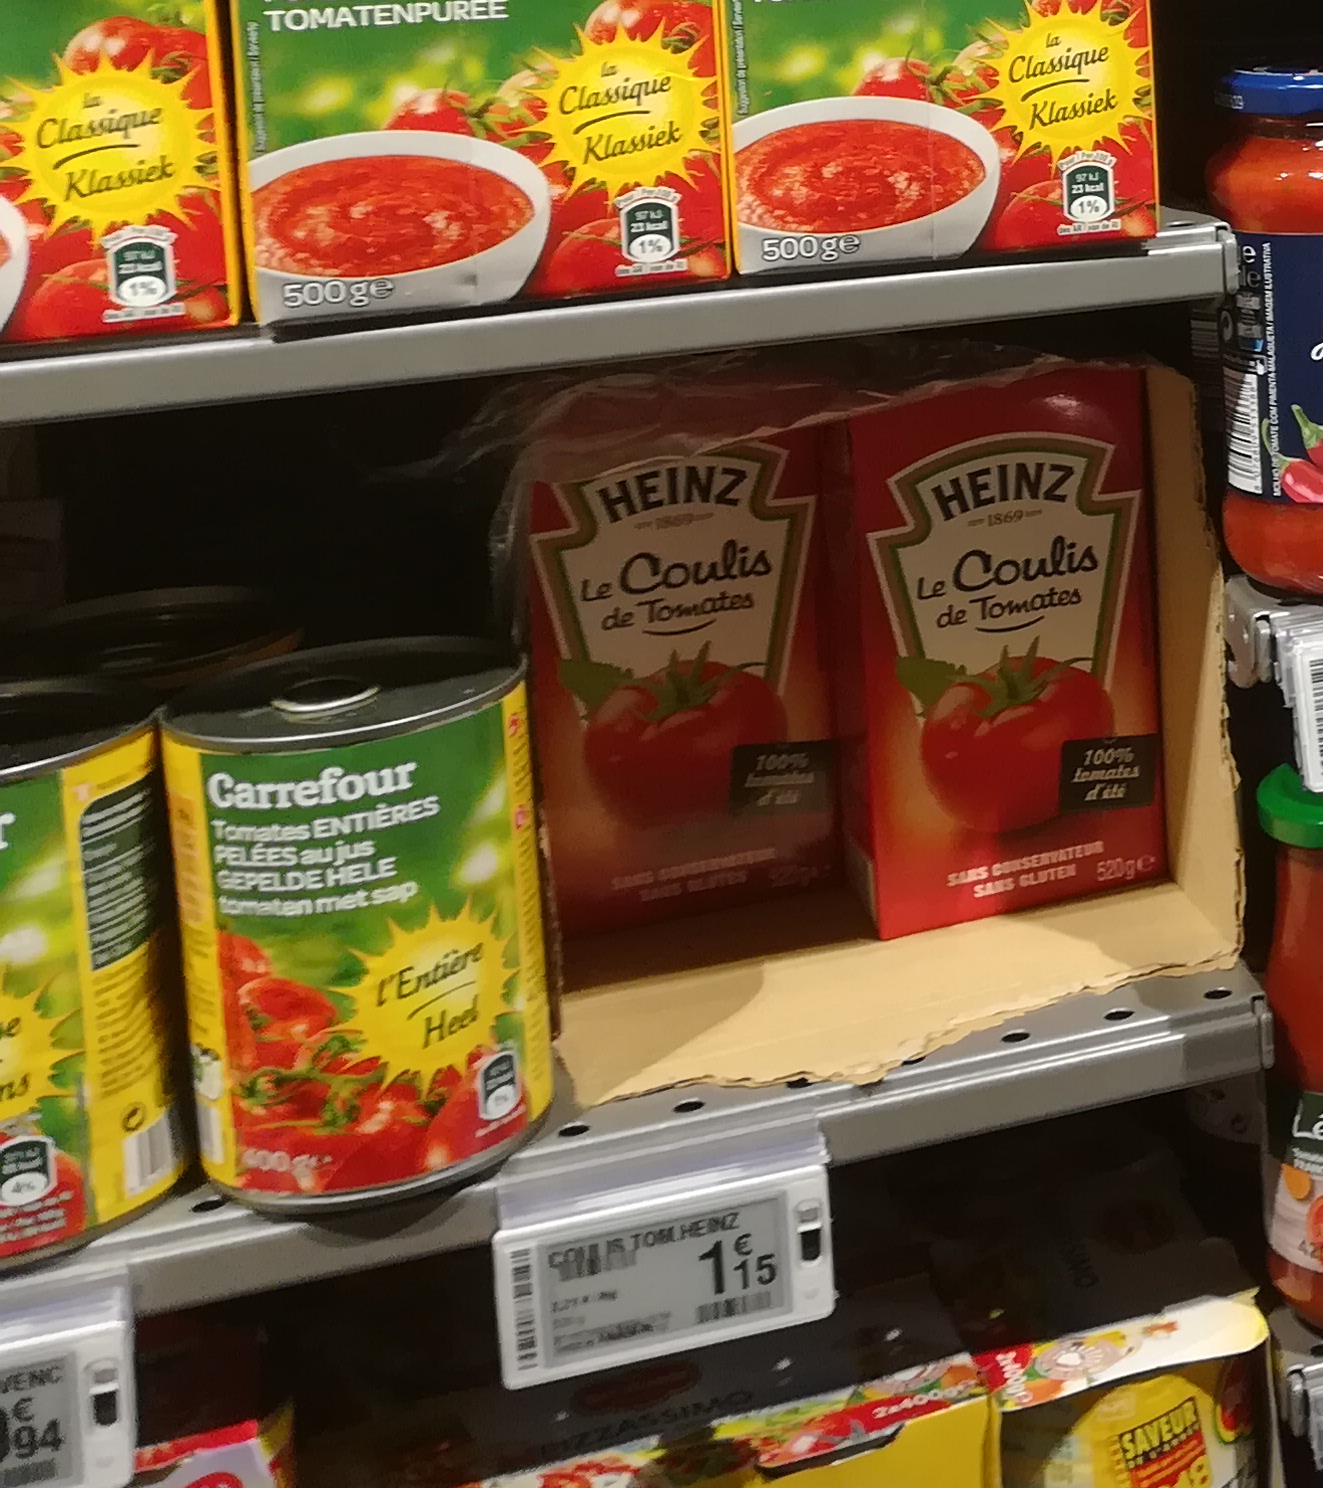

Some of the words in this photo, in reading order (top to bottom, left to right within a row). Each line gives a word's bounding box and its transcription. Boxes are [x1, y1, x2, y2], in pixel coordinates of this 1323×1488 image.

[263, 0, 509, 33] TOMATENPUREE
[1047, 33, 1061, 47] la
[600, 62, 618, 78] la
[1009, 45, 1109, 82] Classique
[559, 75, 672, 114] Classique
[1029, 90, 1118, 130] Klassiek
[36, 106, 162, 146] Classique
[582, 125, 682, 163] Klassiek
[65, 156, 174, 199] Klassiek
[1078, 200, 1099, 215] 1%
[599, 463, 748, 524] HEINZ
[932, 461, 1074, 521] HEINZ
[581, 576, 612, 603] Le
[619, 539, 773, 594] Coulis
[917, 575, 946, 600] Le
[952, 536, 1099, 593] Coulis
[602, 606, 632, 631] de
[641, 589, 754, 623] Tomates
[937, 604, 966, 629] de
[977, 585, 1082, 621] Tomates
[1082, 746, 1134, 765] 100%
[208, 762, 417, 810] Carrefour
[312, 796, 440, 838] ENTIÈRES
[214, 842, 298, 866] PELÉES
[300, 844, 331, 862] au
[334, 838, 375, 864] jus
[326, 857, 398, 887] HELE
[946, 869, 986, 888] SANS
[972, 877, 1015, 898] SANS
[1020, 864, 1077, 888] GLUTEN
[315, 888, 368, 912] met
[368, 880, 418, 908] sap
